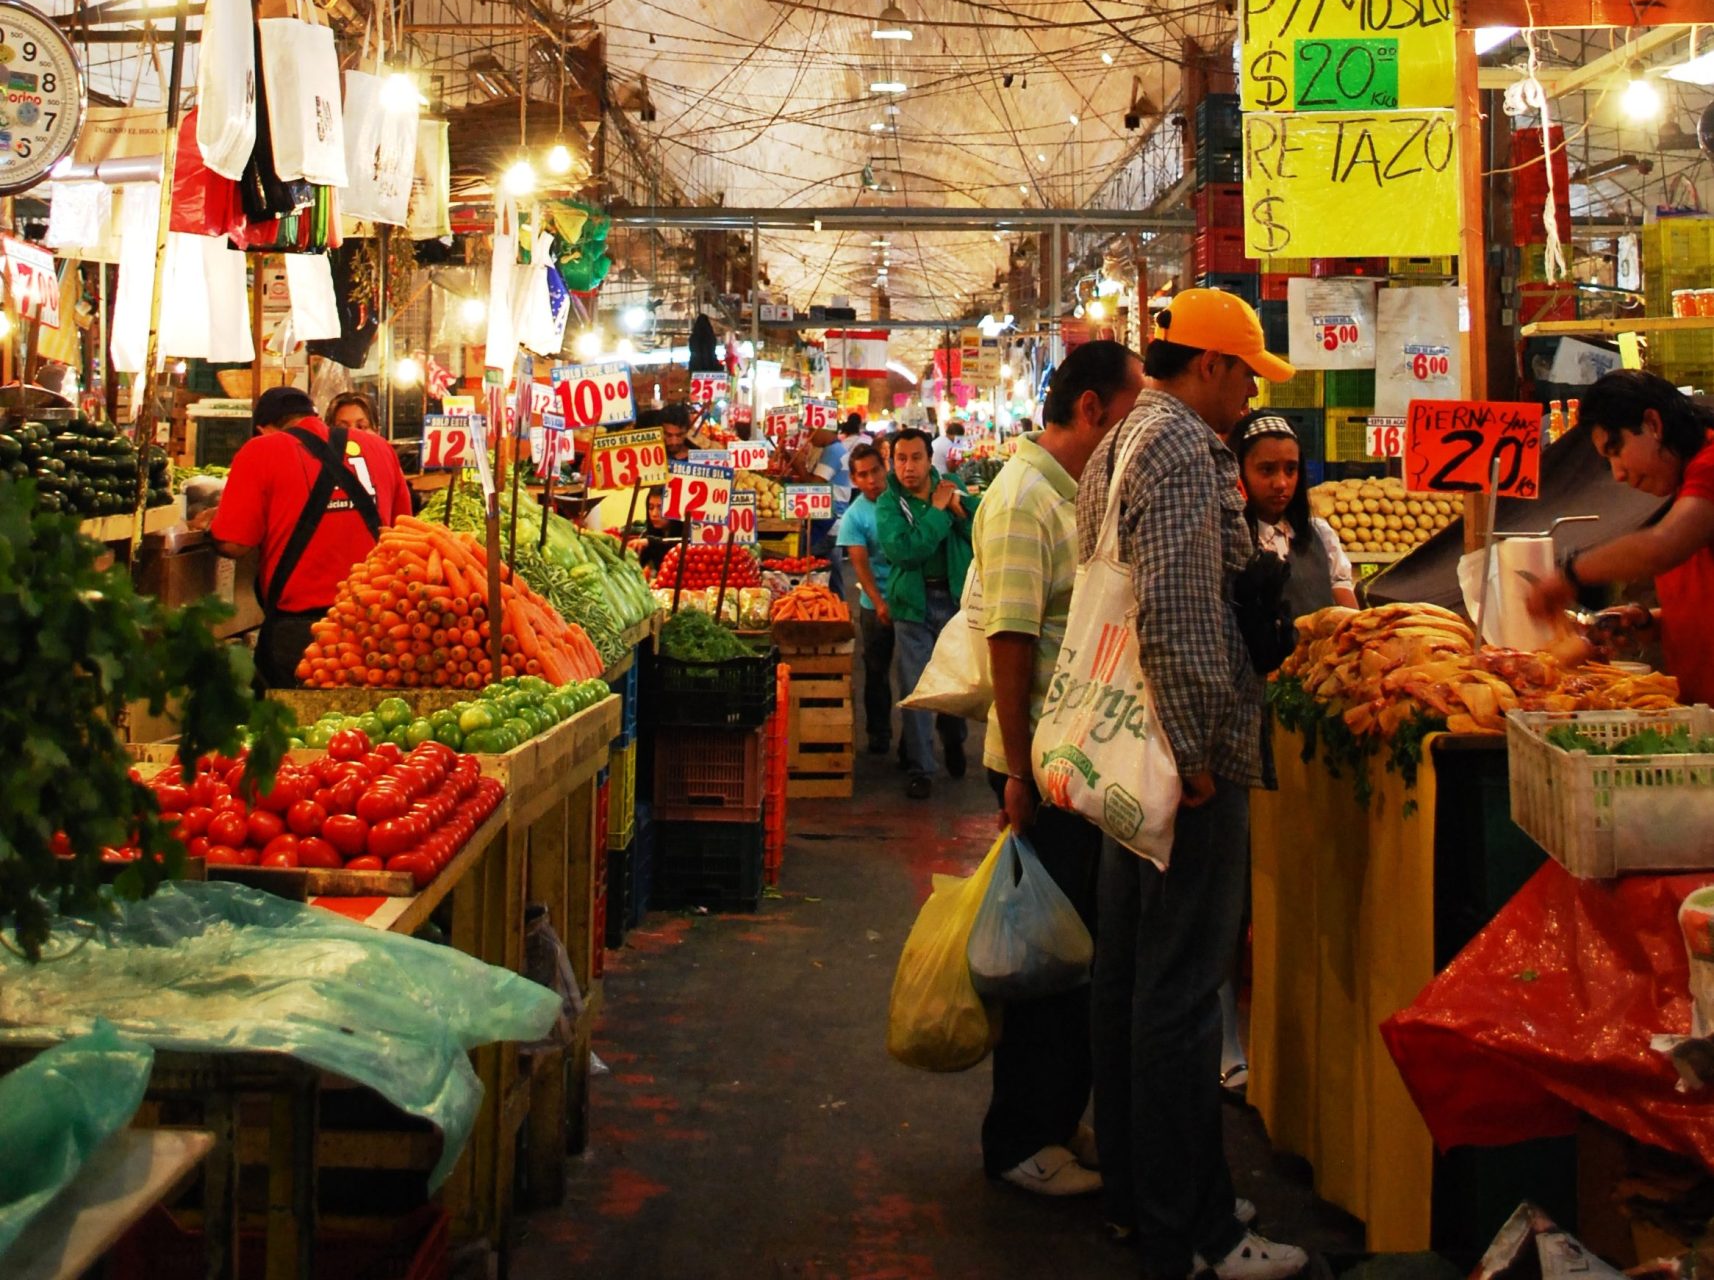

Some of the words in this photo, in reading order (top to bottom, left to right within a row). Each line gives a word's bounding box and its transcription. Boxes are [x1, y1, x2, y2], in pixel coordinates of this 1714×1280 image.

[22, 41, 37, 62] 9
[42, 73, 56, 93] 8
[44, 112, 57, 132] 7
